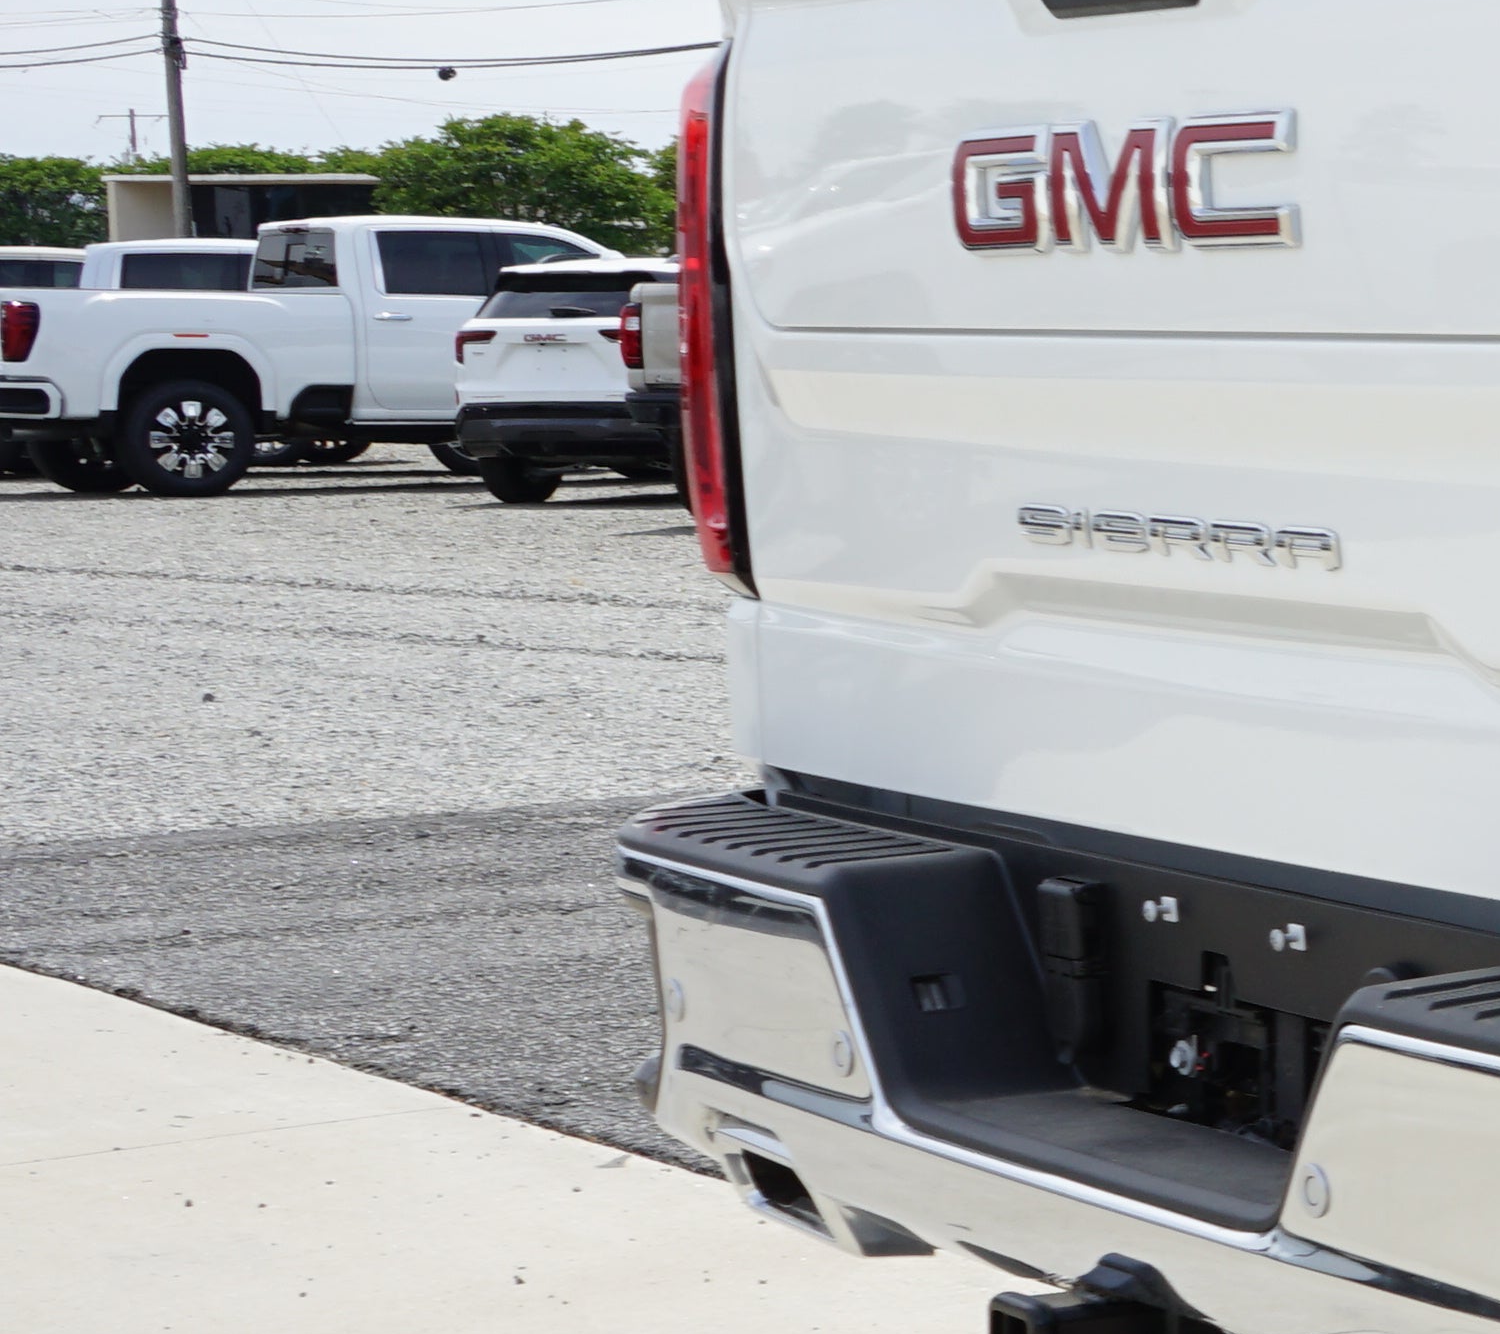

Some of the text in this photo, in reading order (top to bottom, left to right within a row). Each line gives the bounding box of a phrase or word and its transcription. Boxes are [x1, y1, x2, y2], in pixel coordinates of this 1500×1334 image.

[952, 107, 1302, 255] GMC
[522, 333, 567, 343] GMC
[1016, 502, 1343, 571] SIERRA
